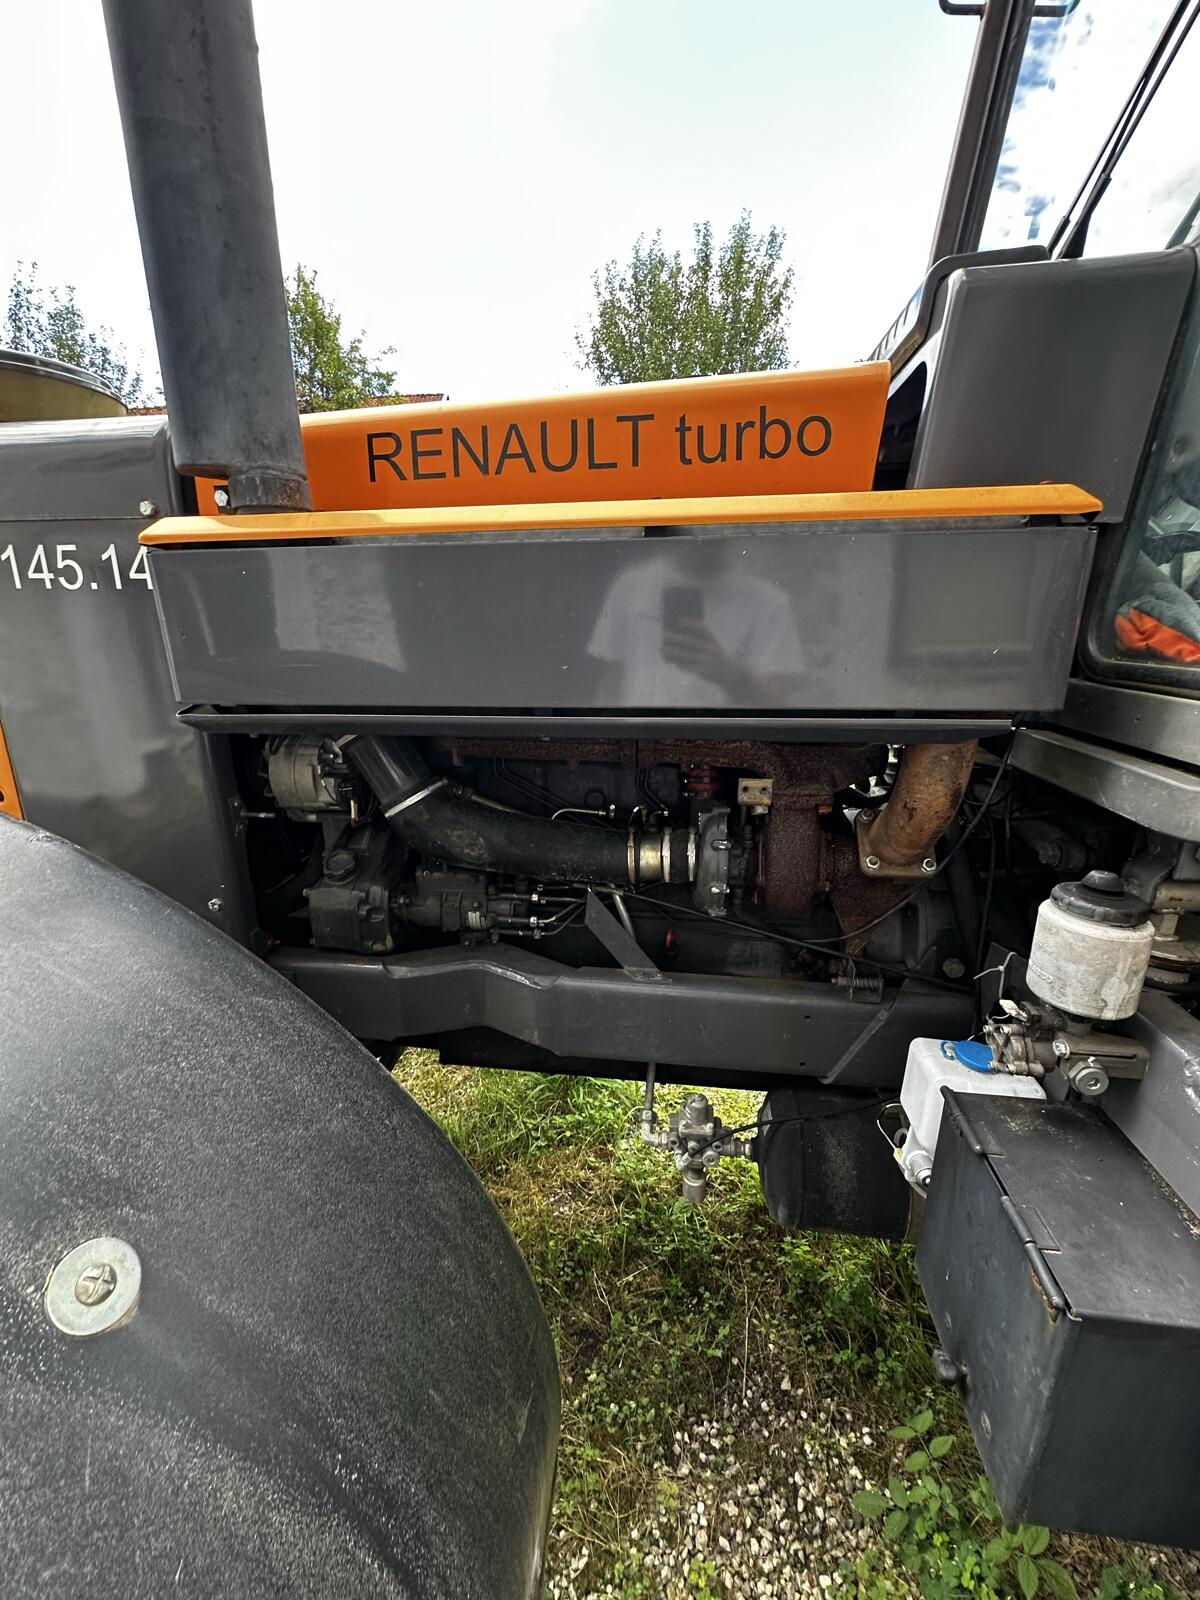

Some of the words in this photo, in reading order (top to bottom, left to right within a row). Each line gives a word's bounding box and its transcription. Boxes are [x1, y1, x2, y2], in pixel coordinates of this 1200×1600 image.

[366, 413, 655, 482] RENAULT
[674, 405, 833, 466] turbo
[1, 543, 154, 590] 145.14
